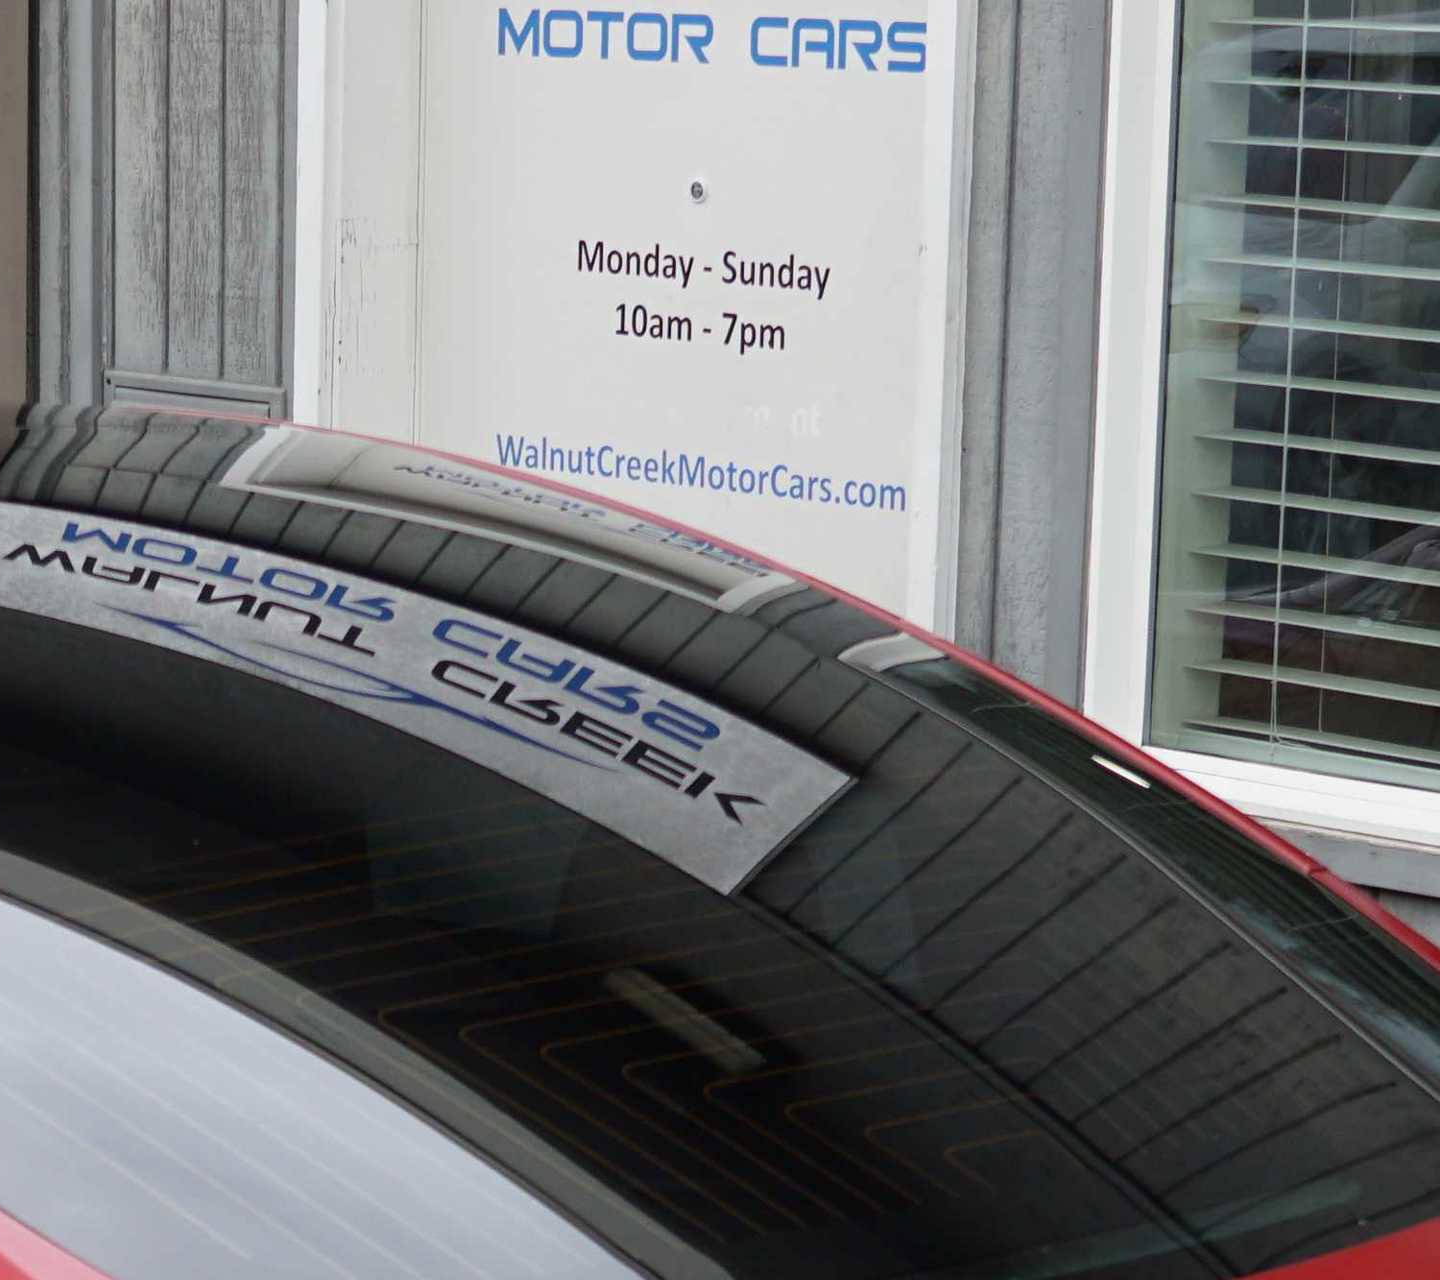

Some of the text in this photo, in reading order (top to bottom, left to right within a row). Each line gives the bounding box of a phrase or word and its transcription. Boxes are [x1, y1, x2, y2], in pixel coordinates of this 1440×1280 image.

[497, 8, 927, 73] MOTOR CARS
[577, 239, 694, 288] Monday
[721, 251, 831, 300] Sunday
[615, 303, 693, 342] 10am
[722, 312, 786, 355] 7pm
[496, 433, 907, 512] WalnutCreekMotorCars.com
